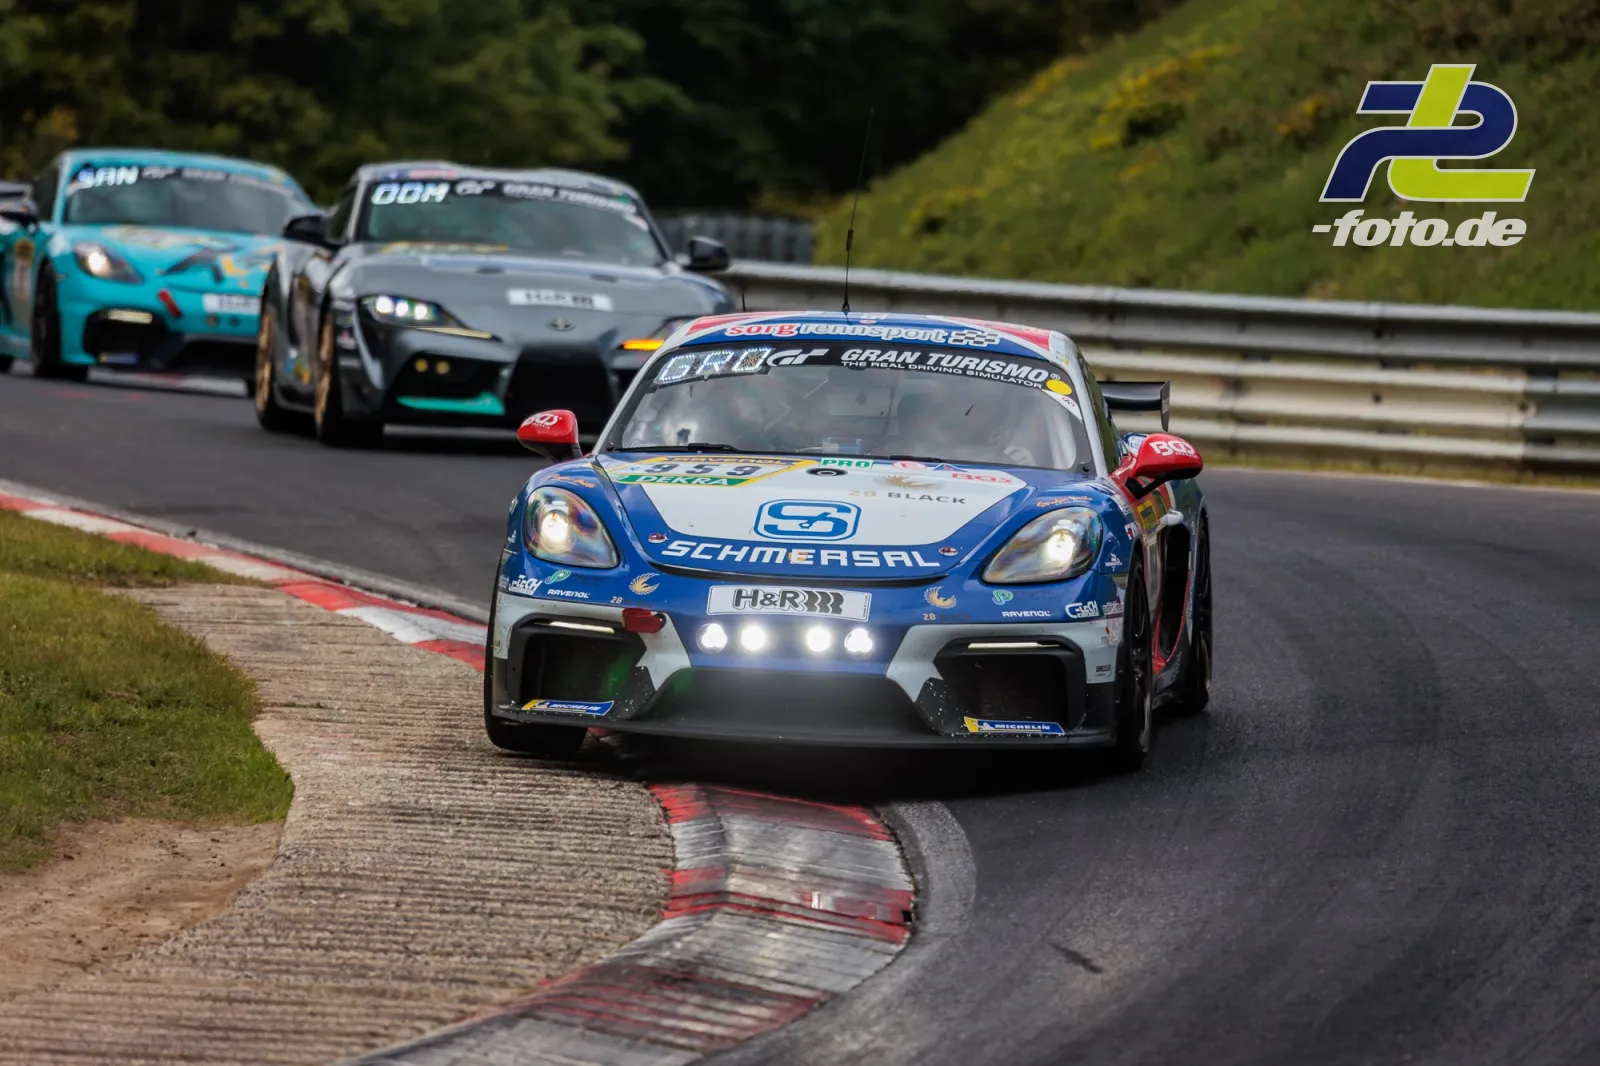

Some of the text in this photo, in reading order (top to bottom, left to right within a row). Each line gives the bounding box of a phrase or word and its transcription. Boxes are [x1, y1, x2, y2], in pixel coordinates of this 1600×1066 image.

[840, 348, 921, 364] GRAN
[870, 362, 906, 370] REAL
[908, 364, 963, 375] DRIVING
[965, 370, 1043, 390] SIMULATOR
[821, 459, 871, 469] PRO
[635, 475, 729, 486] DEKRA
[887, 491, 967, 505] BLACK
[660, 540, 941, 568] SCHMERSAL
[546, 588, 590, 599] RAVENOL
[610, 596, 623, 604] 28
[731, 588, 807, 612] H&R
[922, 613, 936, 621] 28
[1002, 610, 1051, 618] RAVENOL
[994, 723, 1051, 731] MICHELIN
